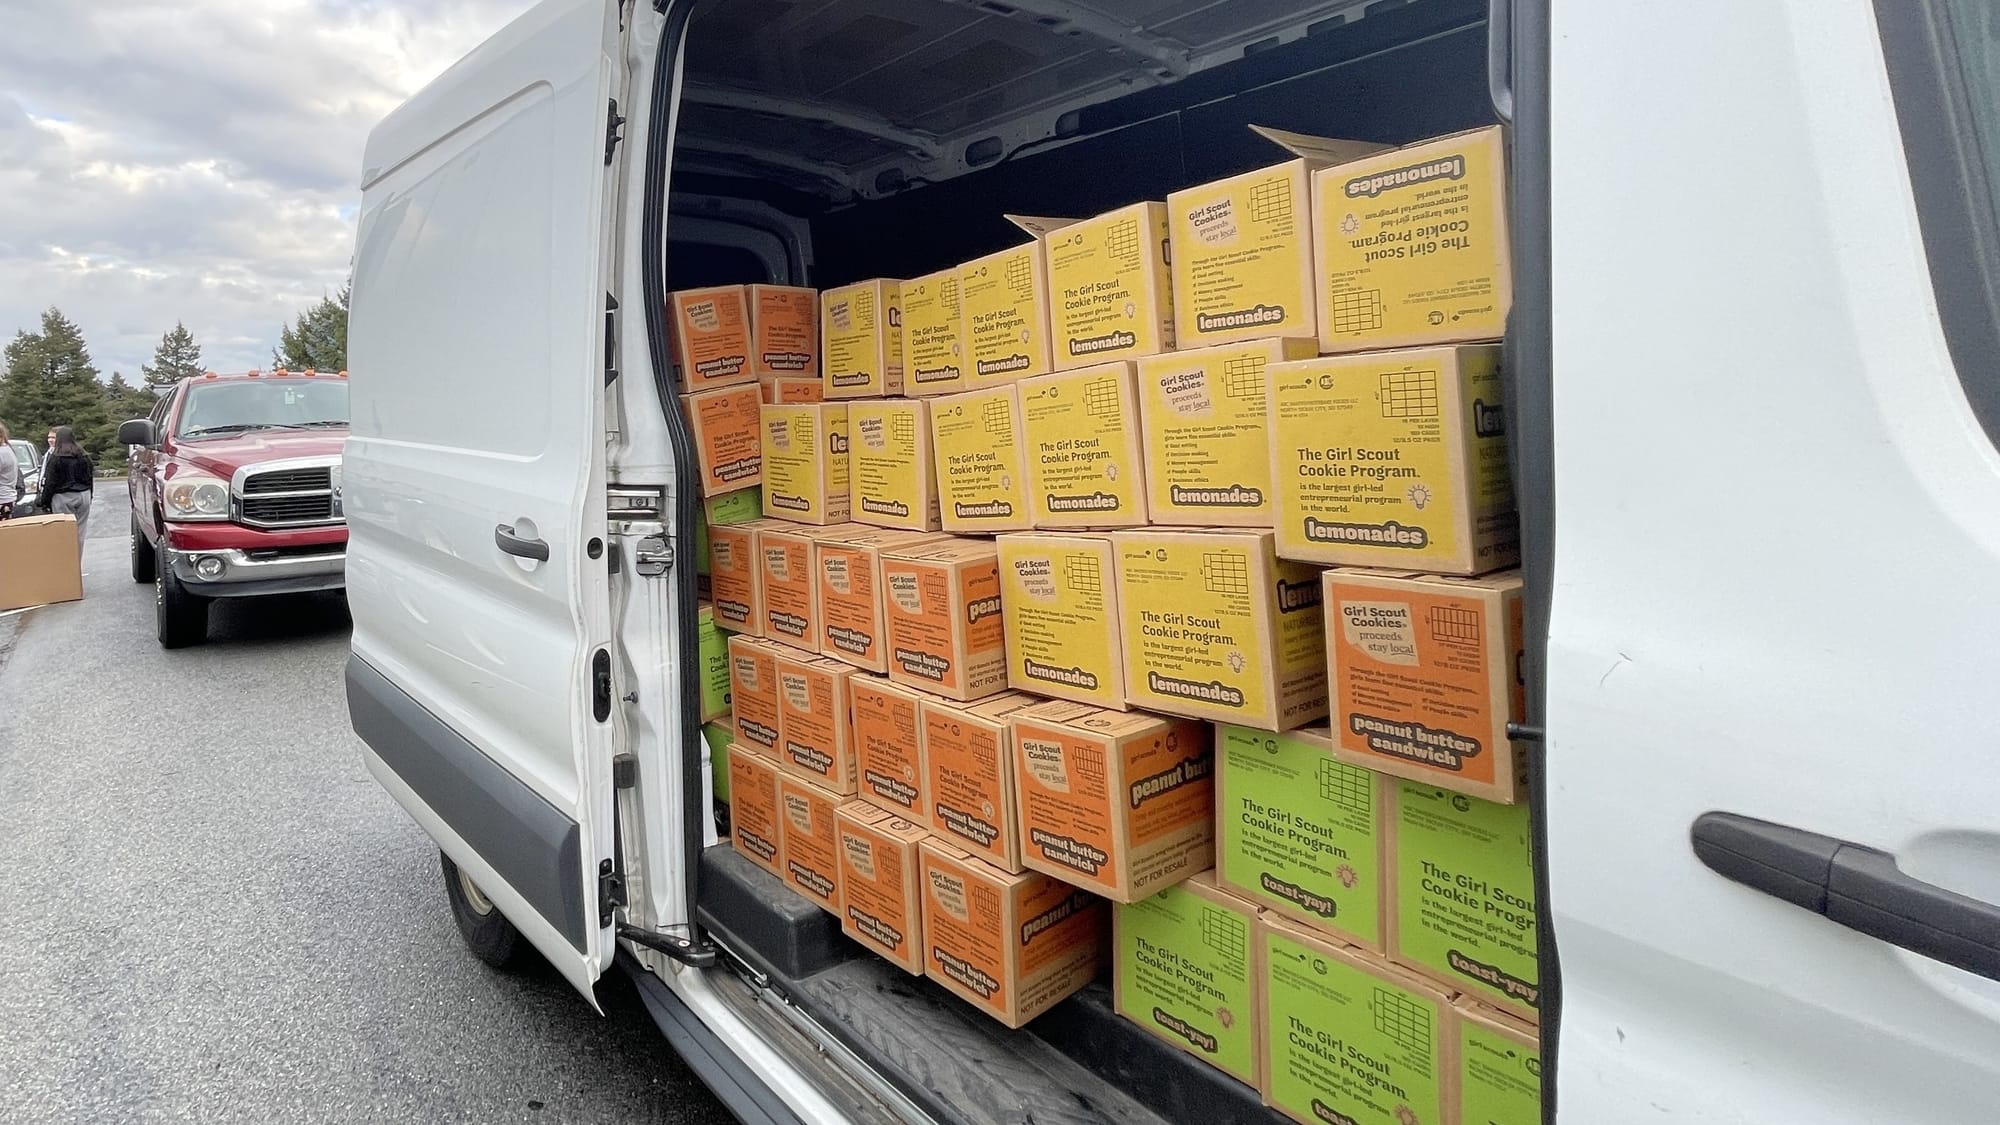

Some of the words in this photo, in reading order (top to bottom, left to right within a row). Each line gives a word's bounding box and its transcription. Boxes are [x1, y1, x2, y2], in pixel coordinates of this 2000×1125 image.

[1347, 156, 1460, 196] lemonades
[1188, 207, 1205, 222] Girl
[1206, 199, 1231, 215] Scout
[1415, 217, 1469, 238] Cookie
[1408, 239, 1436, 256] Girl
[1439, 234, 1470, 250] The
[1363, 244, 1404, 262] Scout
[1063, 288, 1079, 299] The
[1079, 283, 1095, 296] Girl
[1095, 279, 1120, 292] Scout
[1064, 296, 1092, 311] Cookie
[972, 314, 984, 325] The
[984, 311, 997, 322] Girl
[997, 308, 1017, 319] Scout
[1199, 307, 1282, 331] lemonades
[972, 322, 995, 335] Cookie
[1070, 333, 1134, 354] lemonades
[978, 356, 1028, 374] lemonades
[916, 367, 958, 382] lemonades
[1160, 374, 1177, 388] Girl
[1178, 370, 1204, 384] Scout
[1038, 442, 1056, 452] The
[1056, 440, 1073, 451] Girl
[1073, 438, 1100, 449] Scout
[947, 455, 961, 465] The
[961, 453, 975, 464] Girl
[975, 452, 996, 462] Scout
[1040, 452, 1070, 464] Cookie
[1297, 448, 1324, 461] The
[1325, 448, 1353, 461] Girl
[1356, 448, 1401, 461] Scout
[948, 464, 973, 476] Cookie
[1298, 464, 1347, 477] Cookie
[1173, 488, 1260, 503] lemonades
[1299, 483, 1306, 491] is
[1308, 483, 1321, 491] the
[1322, 483, 1351, 493] largest
[1352, 484, 1384, 494] girl-led
[863, 498, 907, 515] lemonades
[1048, 494, 1117, 510] lemonades
[1300, 494, 1364, 504] entrepreneurial
[1364, 497, 1402, 506] program
[956, 502, 1011, 517] lemonades
[1307, 521, 1424, 545] lemonades
[1014, 559, 1029, 569] Girl
[1028, 560, 1050, 568] Scout
[1140, 610, 1162, 624] The
[1162, 612, 1185, 626] Girl
[1186, 615, 1221, 630] Scout
[1343, 606, 1367, 617] Girl
[1369, 607, 1408, 618] Scout
[1141, 624, 1180, 639] Cookie
[1359, 631, 1403, 642] proceeds
[1367, 643, 1390, 654] stay
[1390, 644, 1414, 654] local
[969, 679, 983, 689] NOT
[985, 676, 998, 686] FOR
[1026, 661, 1095, 687] lemonades
[1150, 674, 1241, 704] lemonades
[1354, 716, 1413, 740] peanut
[1416, 727, 1476, 753] butter
[1023, 742, 1038, 752] Girl
[1038, 744, 1062, 755] Scout
[1372, 736, 1457, 766] sandwich
[1132, 767, 1183, 806] peanut
[1241, 796, 1265, 816] The
[1267, 806, 1292, 826] Girl
[1294, 816, 1334, 841] Scout
[1241, 811, 1285, 838] Cookie
[1032, 829, 1069, 851] peanut
[1069, 840, 1105, 863] butter
[1044, 846, 1095, 873] sandwich
[1134, 876, 1148, 888] NOT
[1150, 869, 1163, 880] FOR
[1164, 857, 1188, 874] RESALE
[1264, 876, 1332, 913] toast-yay!
[1420, 860, 1453, 884] The
[1455, 872, 1488, 897] Girl
[1493, 886, 1535, 913] Scou
[1421, 877, 1479, 911] Cookie
[1483, 900, 1536, 930] Progr
[935, 947, 966, 973] peanut
[967, 964, 997, 991] butter
[1450, 954, 1538, 1002] toast-yay
[944, 964, 988, 997] sandwich
[1288, 1014, 1314, 1039] The
[1316, 1029, 1344, 1054] Girl
[1347, 1044, 1391, 1078] Scout
[1288, 1030, 1336, 1066] Cookie
